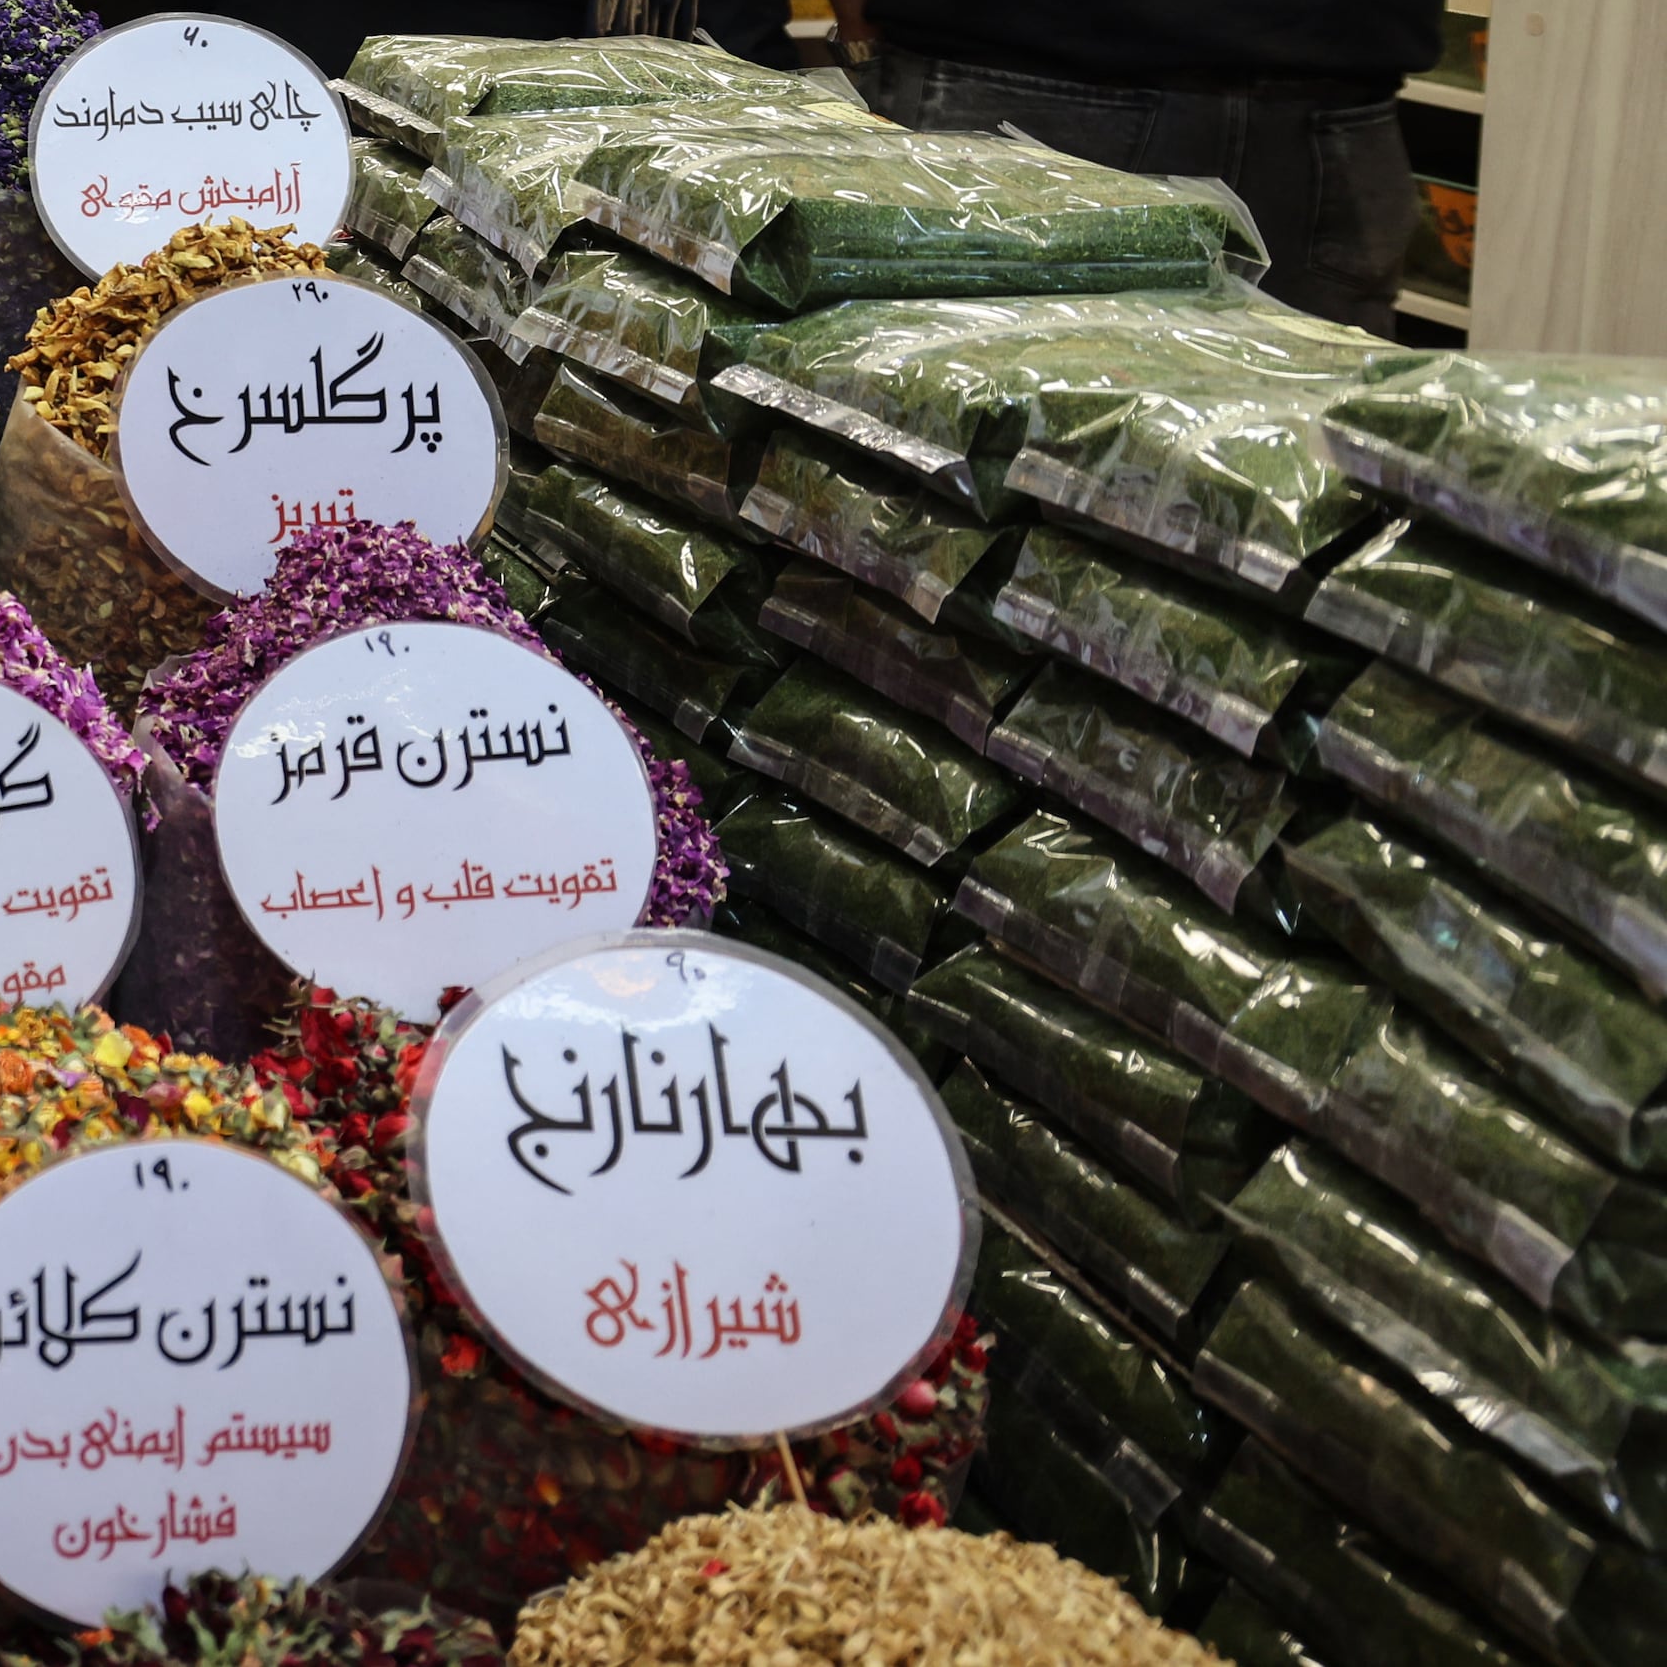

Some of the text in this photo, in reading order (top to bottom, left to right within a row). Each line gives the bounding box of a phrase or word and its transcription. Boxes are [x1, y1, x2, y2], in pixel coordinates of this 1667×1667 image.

[53, 79, 321, 141] چای سیب دماوند
[81, 161, 302, 219] آرامبخش مقوی
[270, 703, 572, 805] نسترن قرمز
[3, 866, 114, 922] تقویت
[260, 858, 618, 921] تقویت قلب و اعصاب
[156, 1274, 356, 1371] نسترن
[584, 1258, 802, 1360] شیرازی
[79, 1404, 185, 1472] ایمنی
[198, 1412, 332, 1466] سیستم
